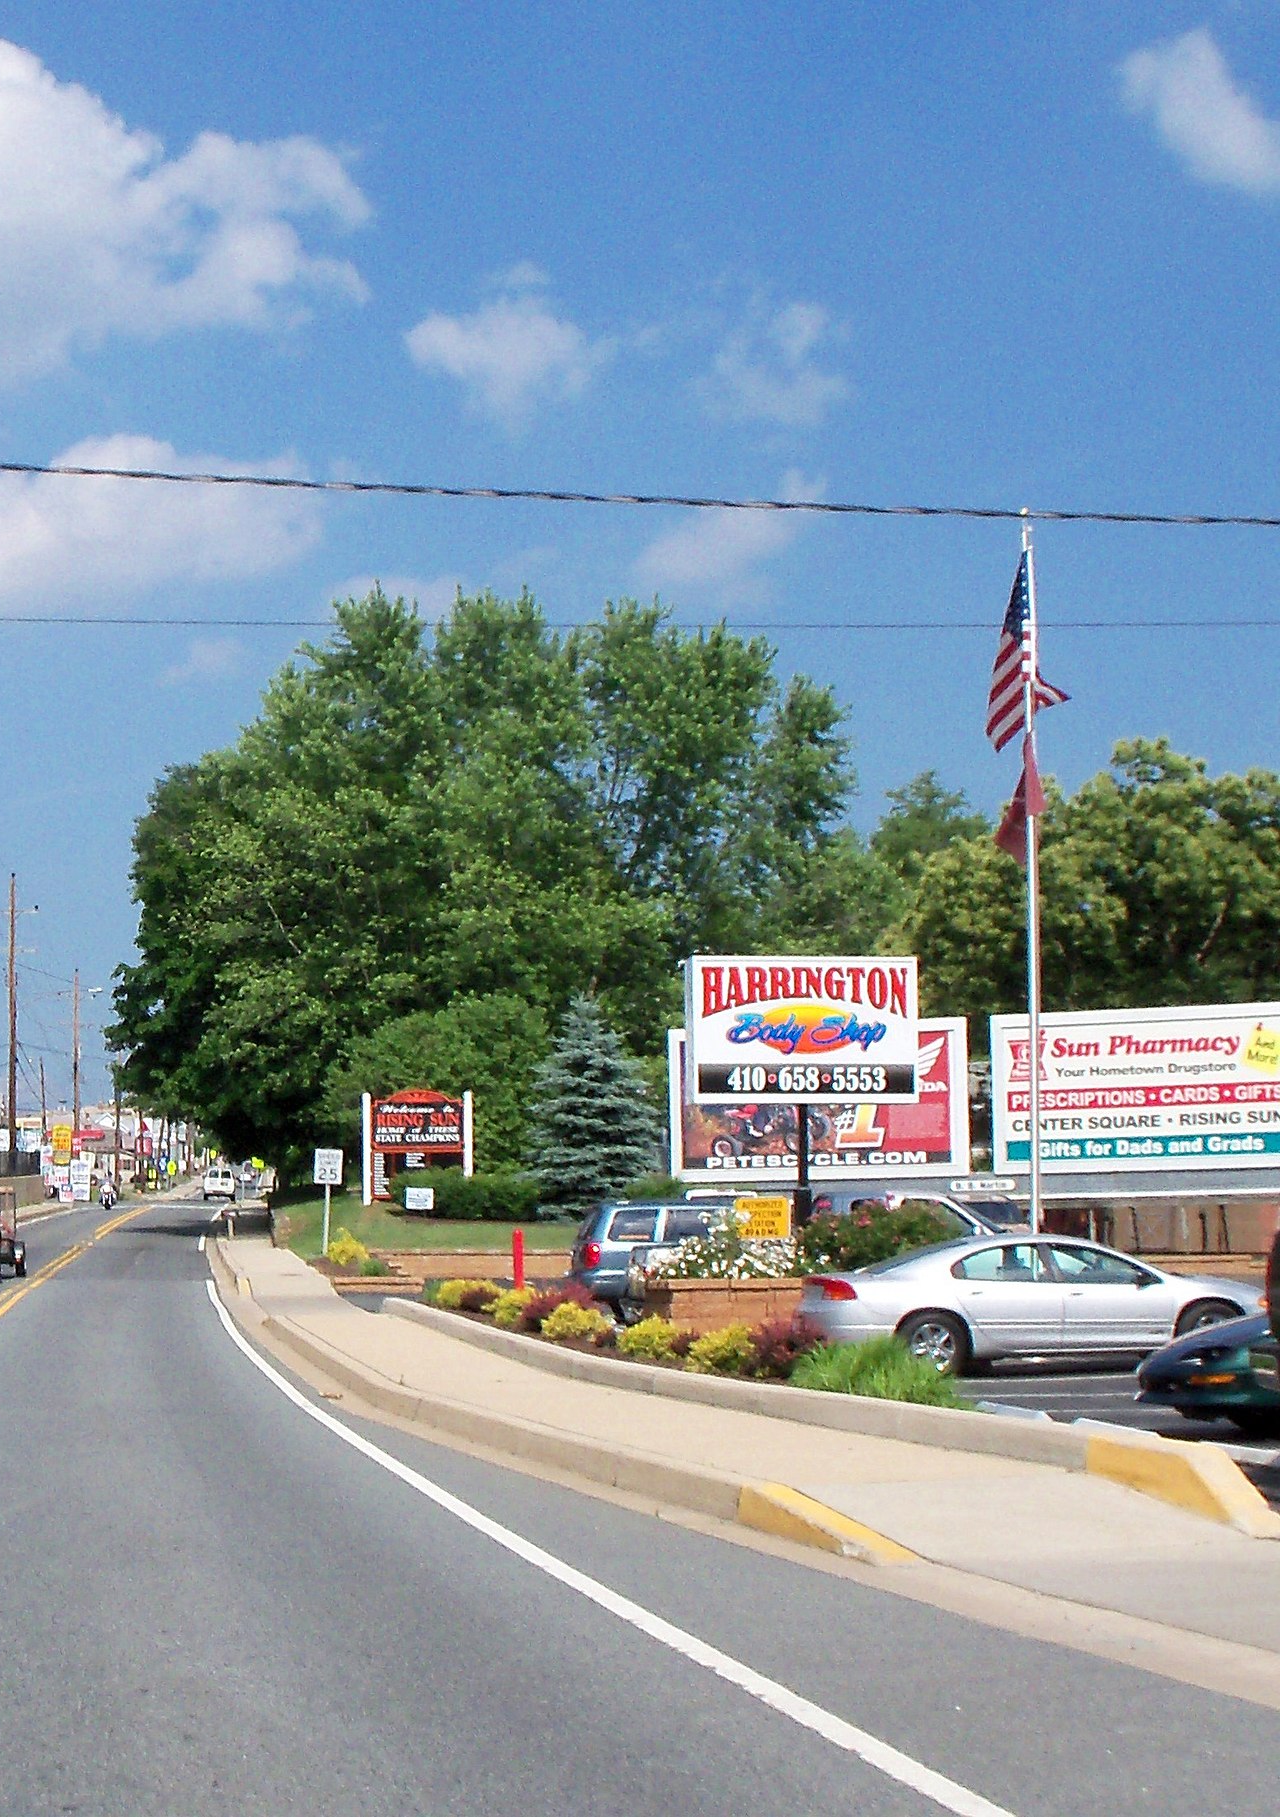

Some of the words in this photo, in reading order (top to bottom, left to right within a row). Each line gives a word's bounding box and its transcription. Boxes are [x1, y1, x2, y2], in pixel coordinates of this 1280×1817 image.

[701, 966, 908, 1019] HARRINGTON
[726, 1013, 806, 1056] Body
[810, 1012, 888, 1052] Shop
[1050, 1037, 1100, 1058] Sun
[1107, 1034, 1240, 1056] Pharmacy
[1055, 1067, 1086, 1078] Your
[1089, 1064, 1164, 1077] Hometown
[1168, 1062, 1237, 1075] Drugstore
[1160, 1086, 1220, 1103] CARDS
[380, 1104, 434, 1113] Welcome
[442, 1105, 454, 1113] to
[377, 1113, 423, 1126] RISING
[430, 1113, 460, 1126] SUN
[1088, 1114, 1161, 1129] SQUARE
[1180, 1111, 1241, 1126] RISING
[375, 1134, 402, 1142] STATE
[405, 1134, 460, 1142] CHAMPIONS
[1039, 1140, 1081, 1157] Gifts
[1085, 1139, 1111, 1155] for
[1116, 1137, 1164, 1155] Dads
[1167, 1137, 1204, 1153] and
[1206, 1135, 1265, 1152] Grads
[707, 1151, 927, 1168] PETESCCLE.COM
[318, 1168, 337, 1181] 25
